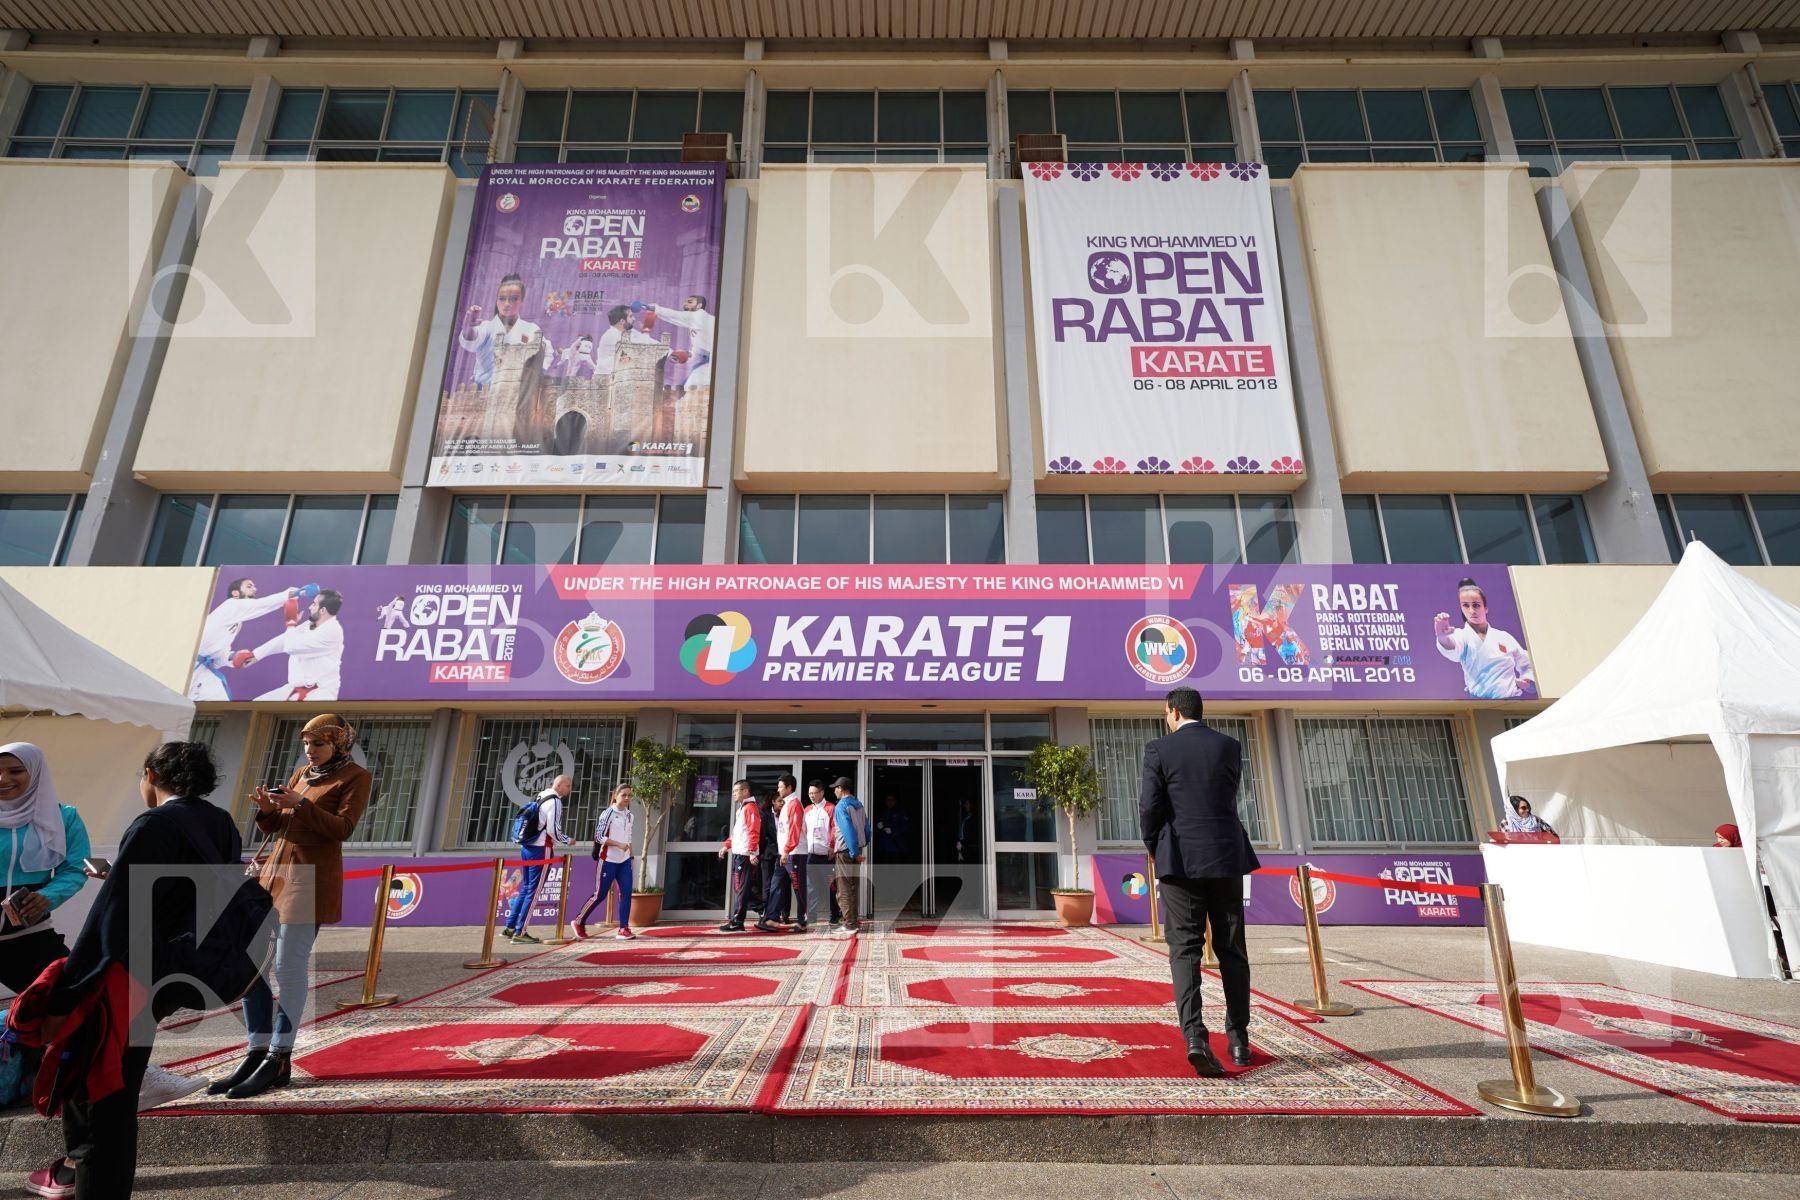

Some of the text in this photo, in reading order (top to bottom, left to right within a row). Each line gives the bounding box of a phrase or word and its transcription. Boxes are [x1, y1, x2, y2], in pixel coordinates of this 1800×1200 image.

[489, 177, 715, 186] ROYAL MOROCCAN KARATE FEDERATION
[563, 215, 646, 236] OPEN
[540, 237, 643, 259] RABAT
[1087, 236, 1256, 248] KING MOHAMMED VI
[583, 260, 637, 271] KARATE
[1087, 251, 1263, 295] OPEN
[574, 290, 605, 300] RABAT
[1052, 298, 1265, 343] RABAT
[1139, 351, 1266, 373] KARATE
[1133, 380, 1154, 390] 06
[1165, 380, 1186, 390] 08
[1190, 379, 1234, 390] APRIL
[1237, 379, 1278, 390] 2018
[642, 442, 686, 451] KARATE
[415, 584, 523, 593] KING MOHAMMED VI
[564, 576, 1184, 590] UNDER THE HIGH PATRONAGE OF HIS MAJESTY THE KING MOHAMMED VI
[1311, 584, 1399, 611] RABAT
[410, 594, 522, 625] OPEN
[1147, 617, 1170, 625] WORLD
[1316, 613, 1405, 623] PARIS ROTTERDAM
[1318, 625, 1407, 636] DUBAI ISTANBUL
[375, 628, 517, 662] RABAT
[504, 636, 515, 661] 2018
[768, 616, 1072, 682] KARATE 1
[1144, 642, 1176, 656] WKF
[1319, 637, 1410, 651] BERLIN TOKYO
[434, 665, 506, 680] KARATE
[762, 662, 1022, 682] PREMIER LEAGUE
[1135, 663, 1191, 682] KARATE FEDERATION
[1238, 668, 1264, 683] 06
[1277, 668, 1303, 683] 08
[1308, 668, 1361, 683] APRIL
[1365, 668, 1416, 683] 2018
[1395, 867, 1454, 885] OPEN
[390, 889, 409, 899] WKF
[1420, 906, 1457, 916] KARATE
